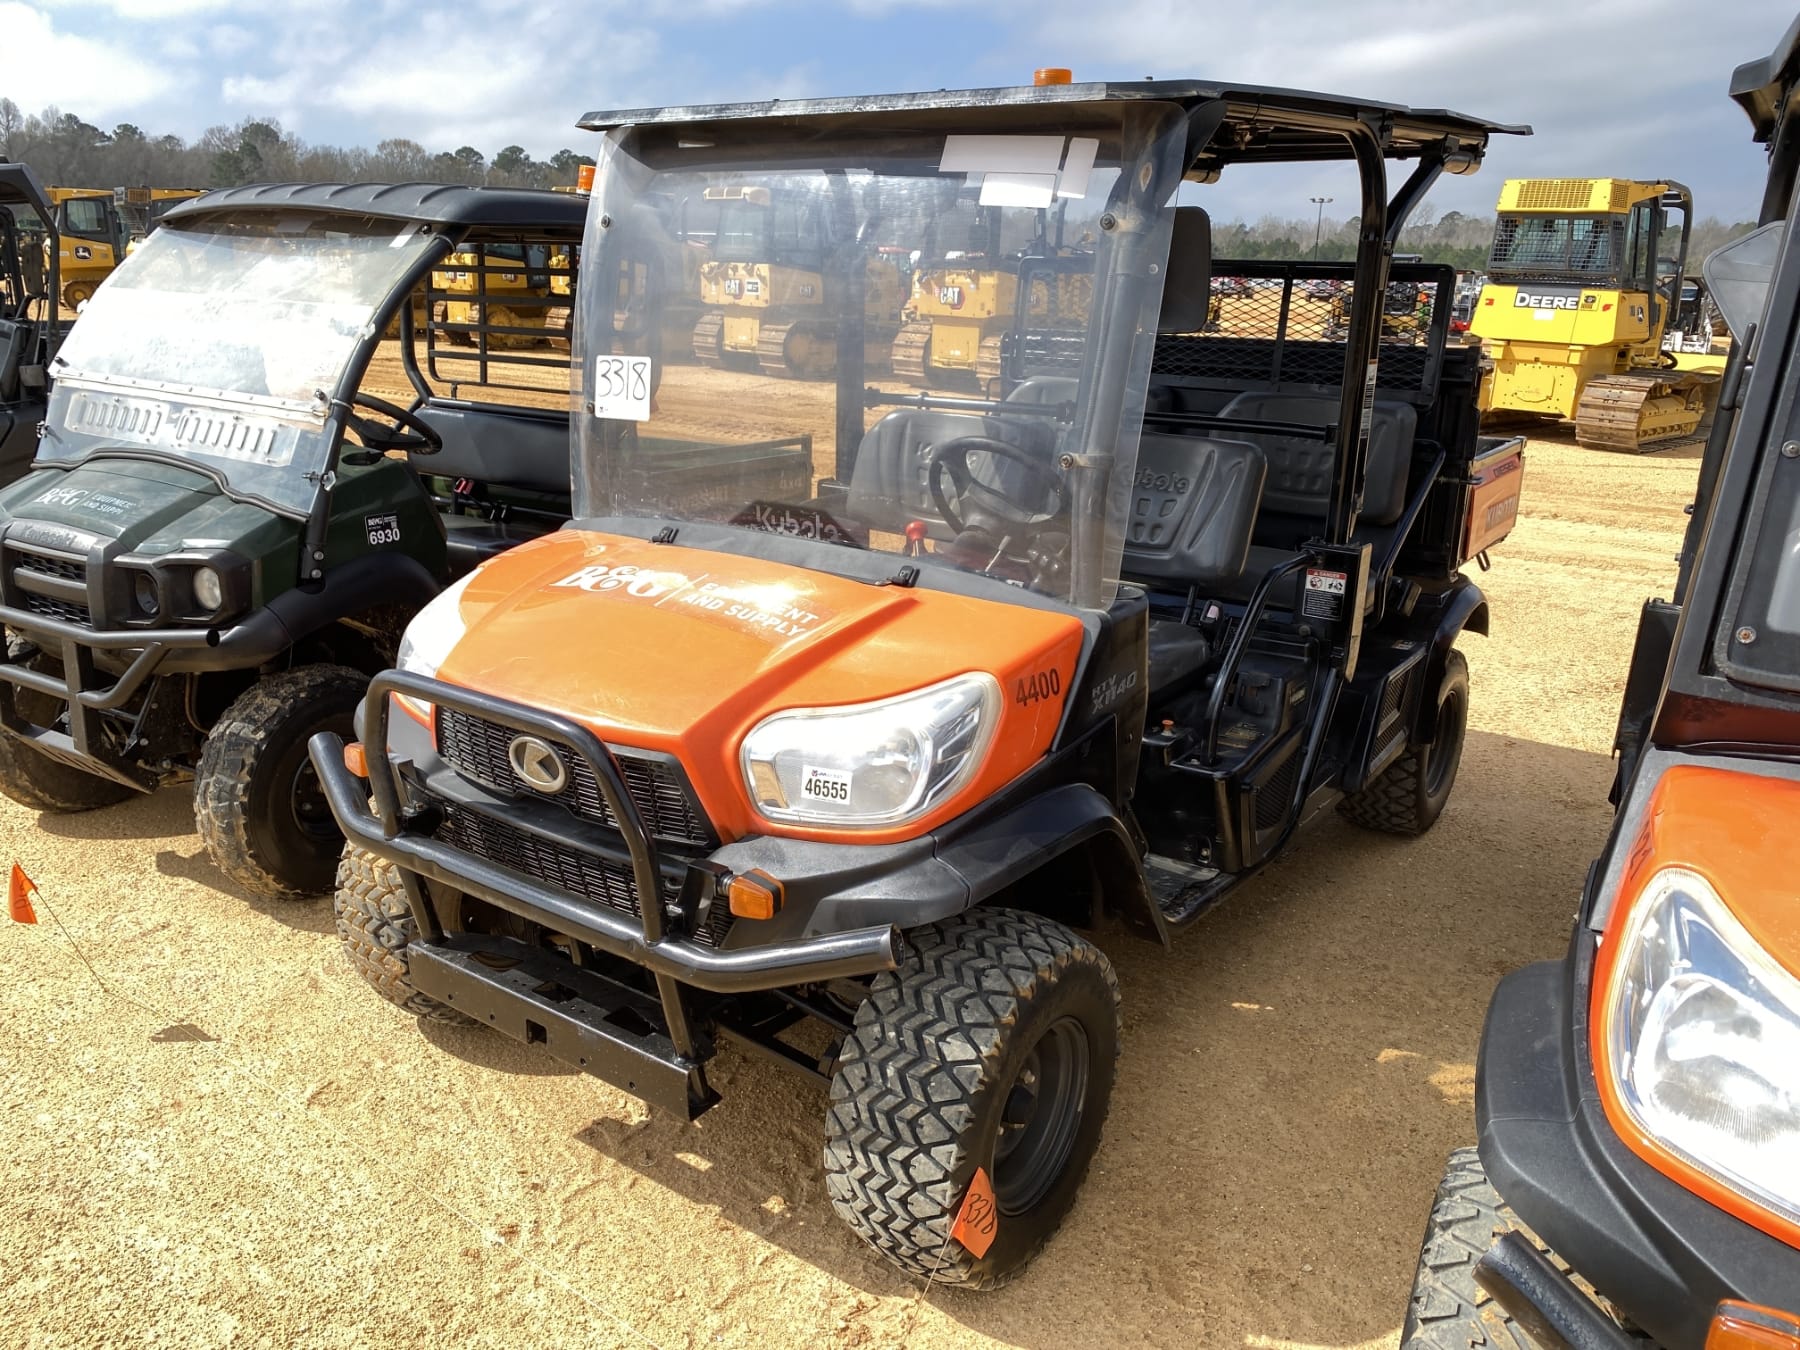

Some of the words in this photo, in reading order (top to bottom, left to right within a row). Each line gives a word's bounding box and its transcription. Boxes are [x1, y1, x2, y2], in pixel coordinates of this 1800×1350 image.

[940, 287, 960, 304] CAT
[1514, 292, 1579, 310] DEERE
[599, 358, 647, 401] 3318
[369, 528, 400, 545] 6930
[754, 503, 839, 541] Kubota
[679, 592, 725, 611] AND
[724, 603, 808, 638] SUPPLY
[1016, 667, 1060, 707] 4400
[804, 777, 848, 800] 46555
